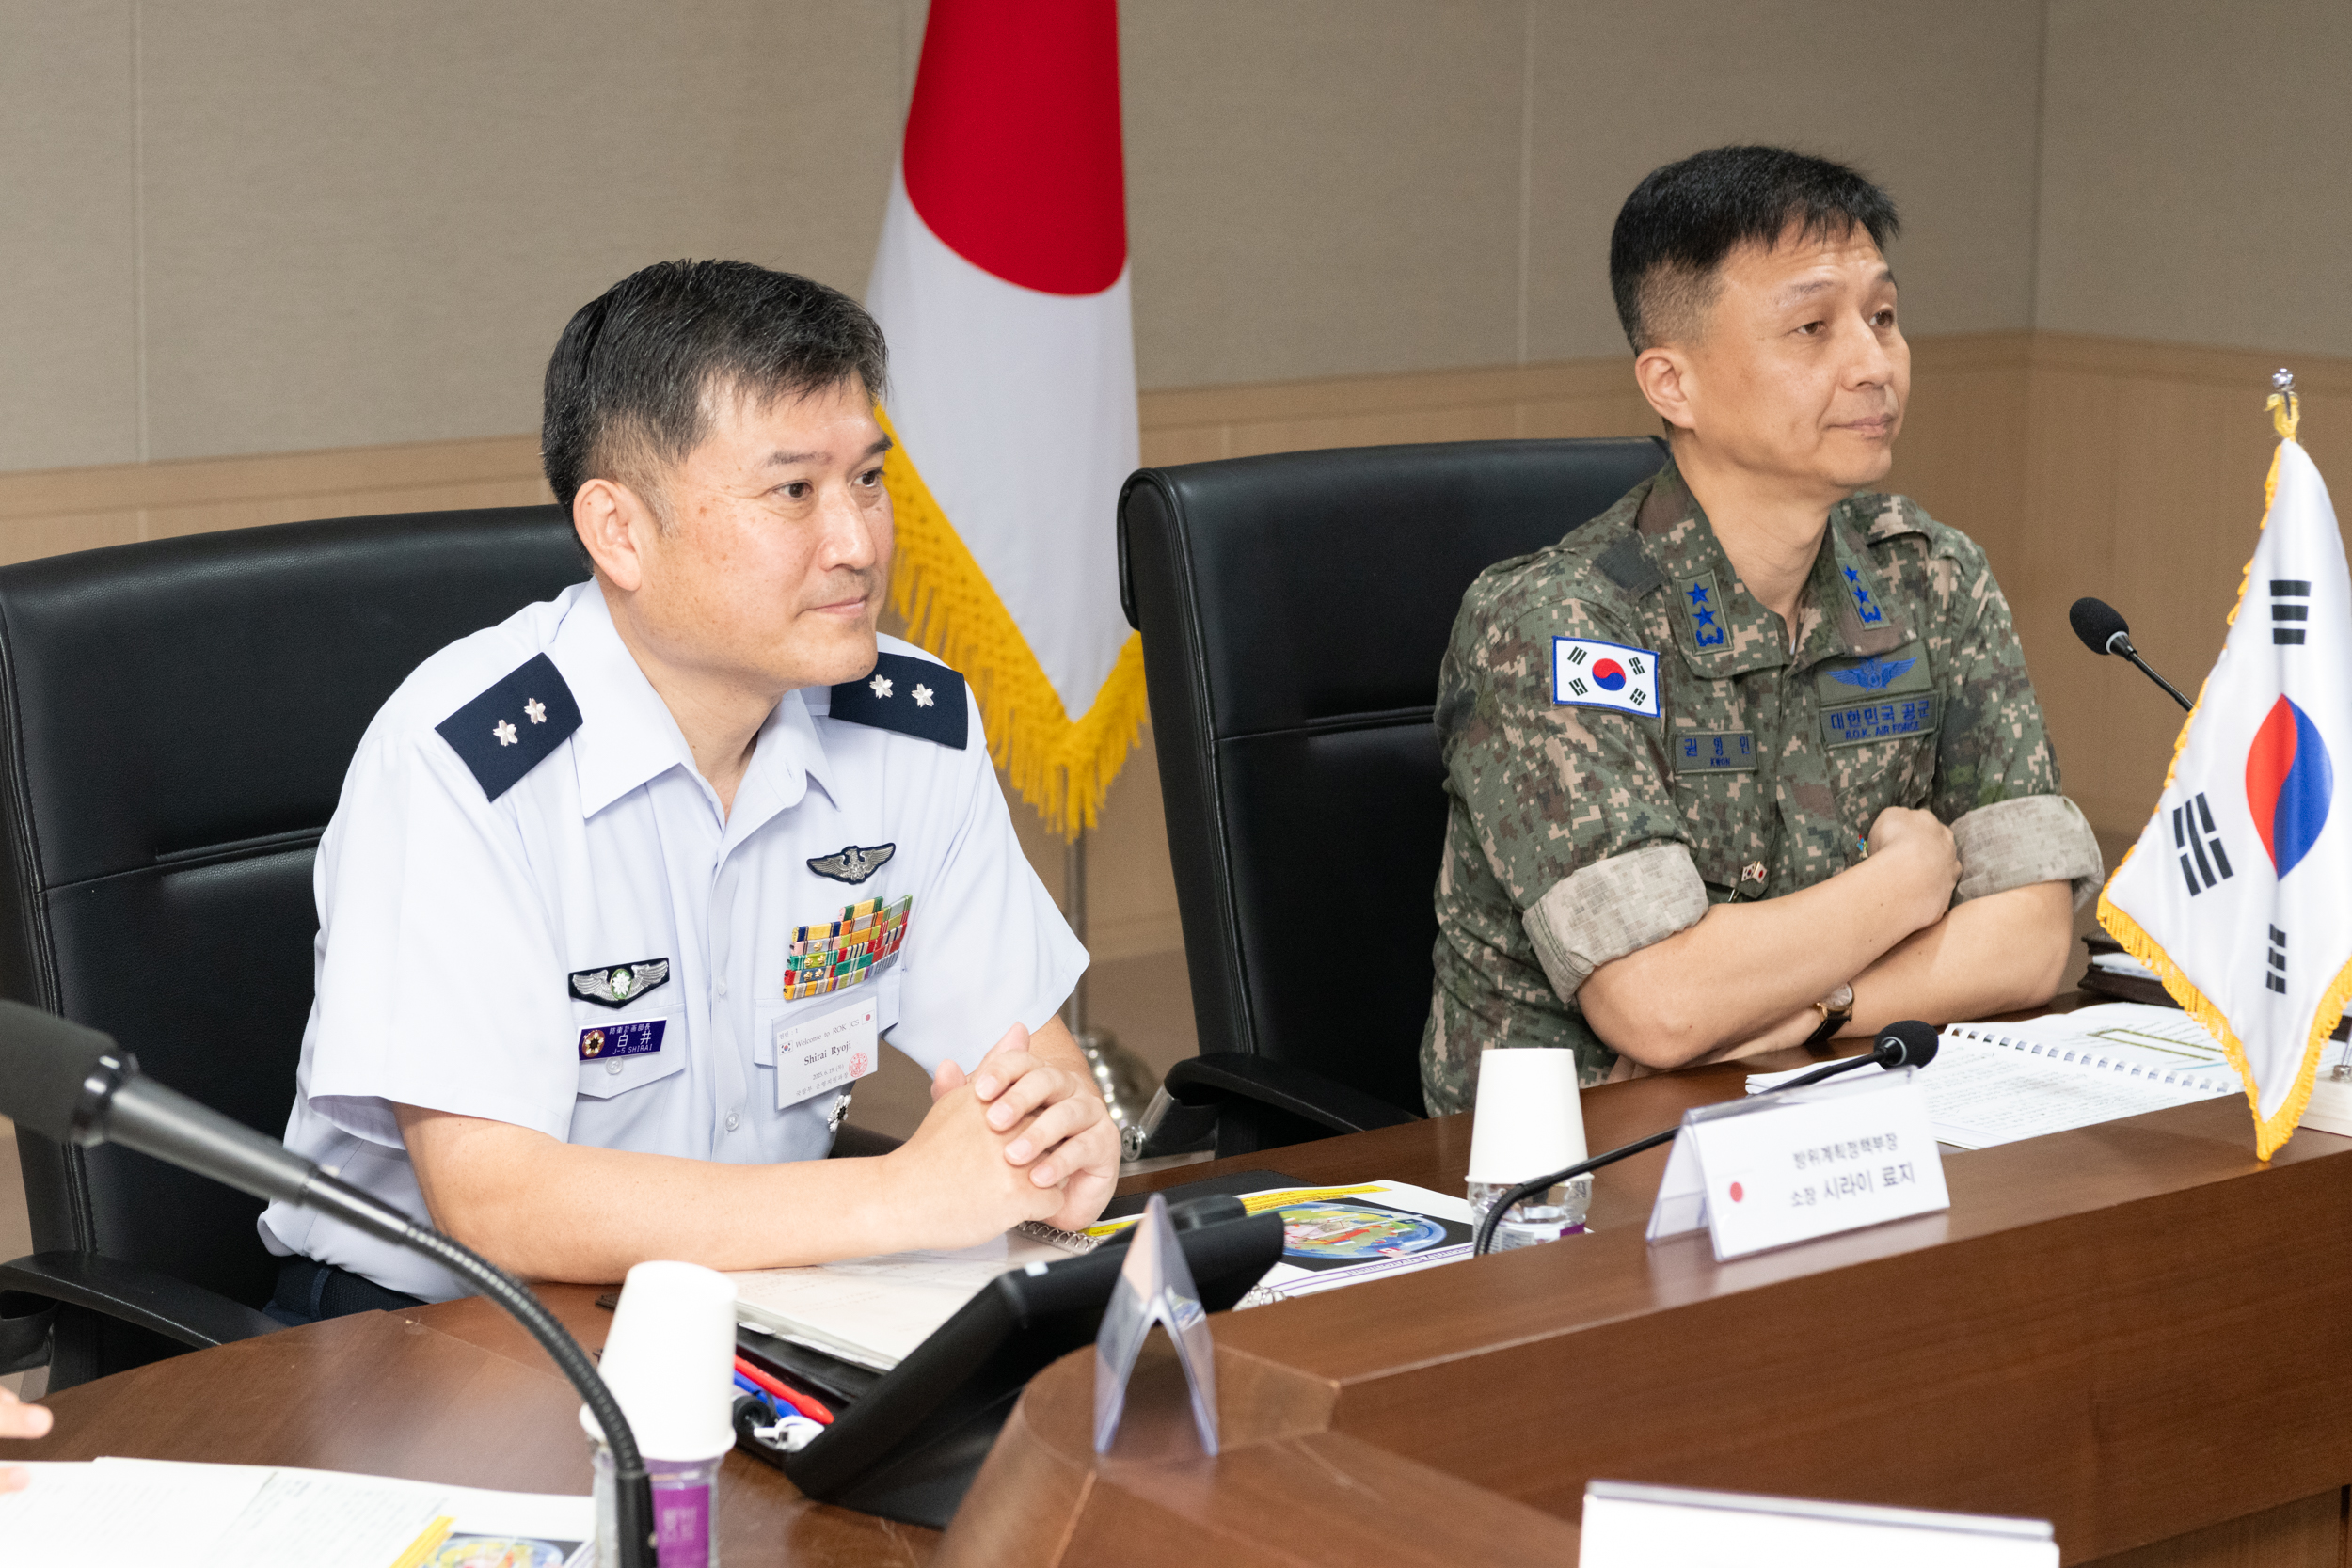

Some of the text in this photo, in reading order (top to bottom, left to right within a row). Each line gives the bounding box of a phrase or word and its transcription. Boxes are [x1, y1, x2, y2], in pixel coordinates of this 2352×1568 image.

[1830, 700, 1930, 730] 대한민국 공군
[1845, 721, 1920, 740] R.O.K. AIR FORCE
[1710, 757, 1731, 768] KWON
[795, 1035, 822, 1048] Welcome
[832, 1023, 847, 1035] ROK
[849, 1019, 860, 1030] JCS
[628, 1043, 653, 1053] SHIRAI
[803, 1039, 851, 1066] Shirai Ryoji
[1791, 1160, 1915, 1207] 소장 시라이 료지
